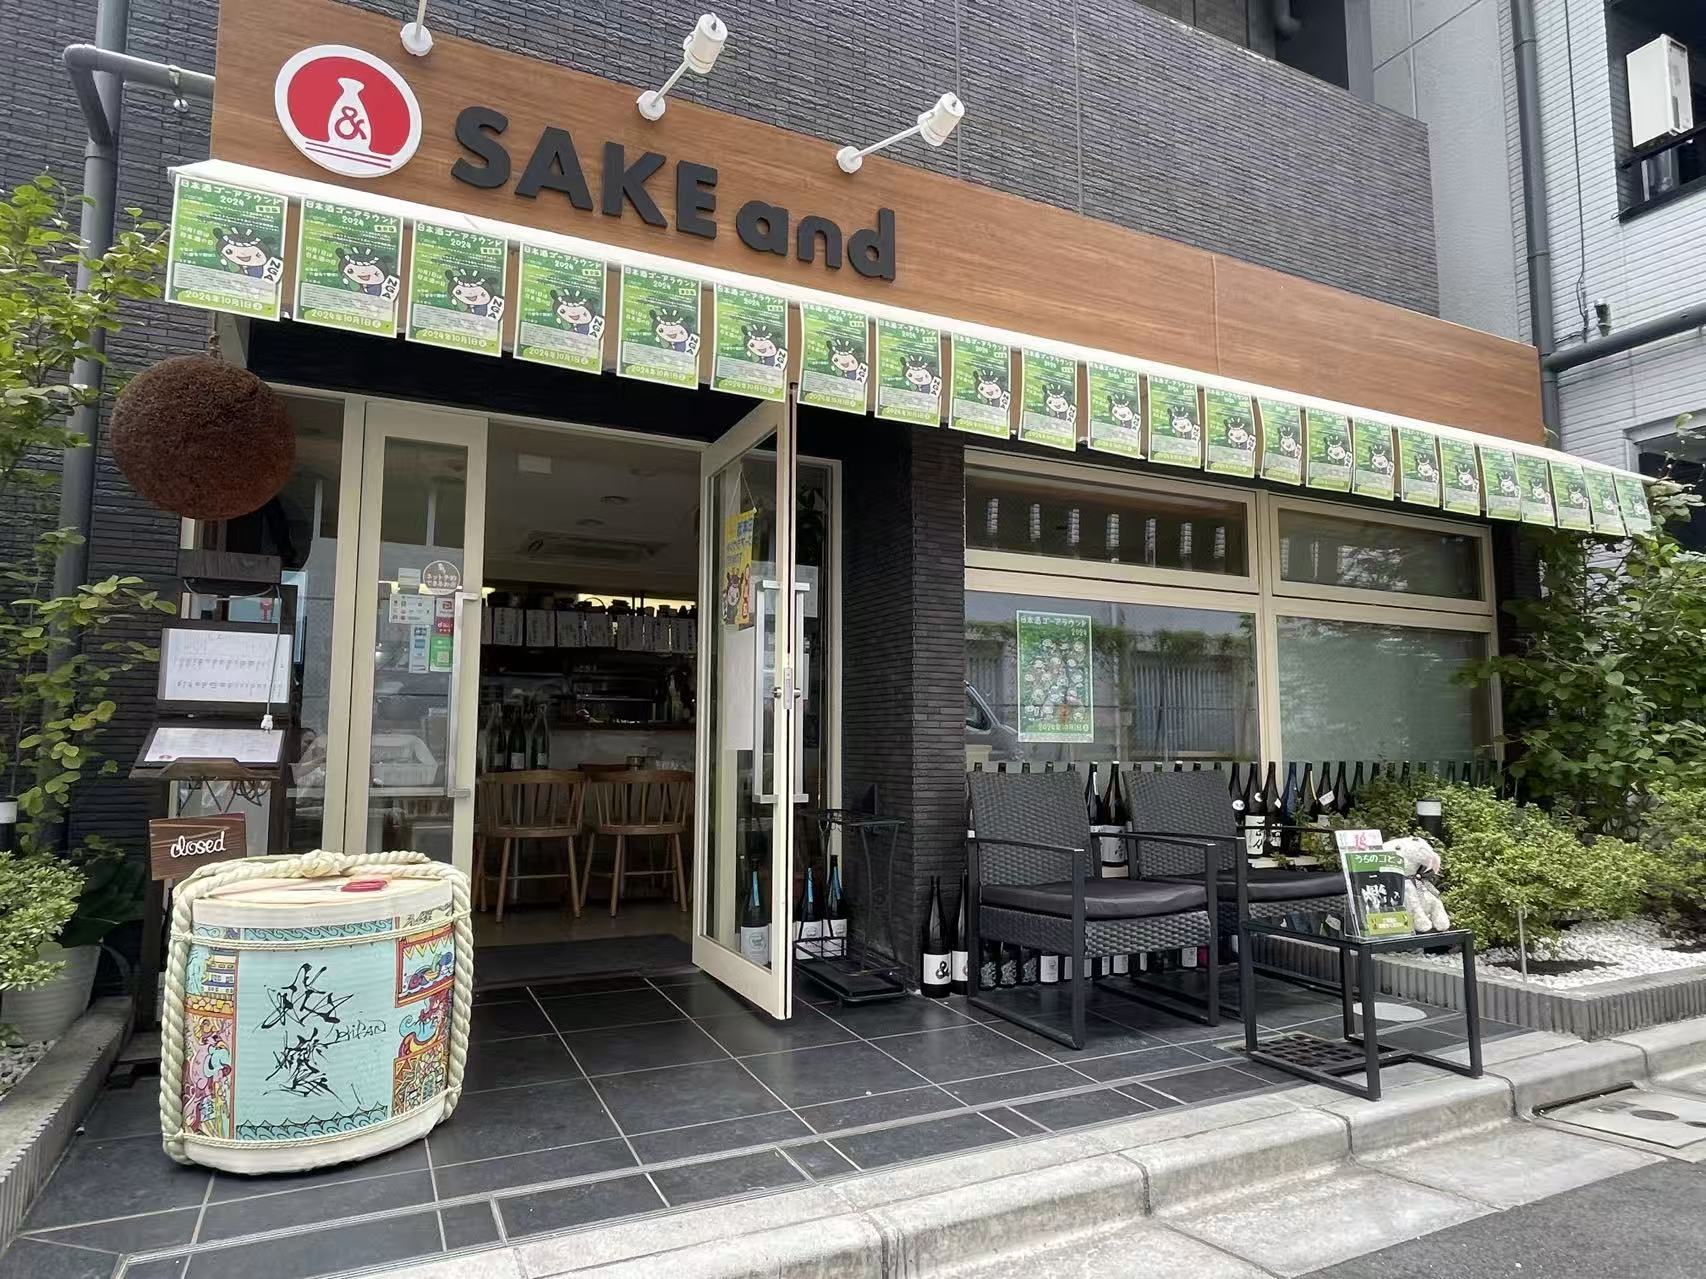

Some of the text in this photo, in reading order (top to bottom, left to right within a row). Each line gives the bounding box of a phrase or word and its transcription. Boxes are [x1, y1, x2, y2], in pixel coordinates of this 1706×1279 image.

[180, 178, 283, 206] 日本酒ゴーアラウンド
[219, 195, 244, 206] 2024
[450, 106, 896, 282] SAKE and
[305, 201, 396, 225] 日本酒ゴーアラウンド
[342, 216, 363, 226] 2024
[417, 223, 501, 248] 日本酒ゴーアラウンド
[450, 238, 470, 248] 2024
[523, 245, 601, 269] 日本酒ゴーアラウンド
[554, 260, 573, 270] 2024
[170, 831, 226, 858] closed
